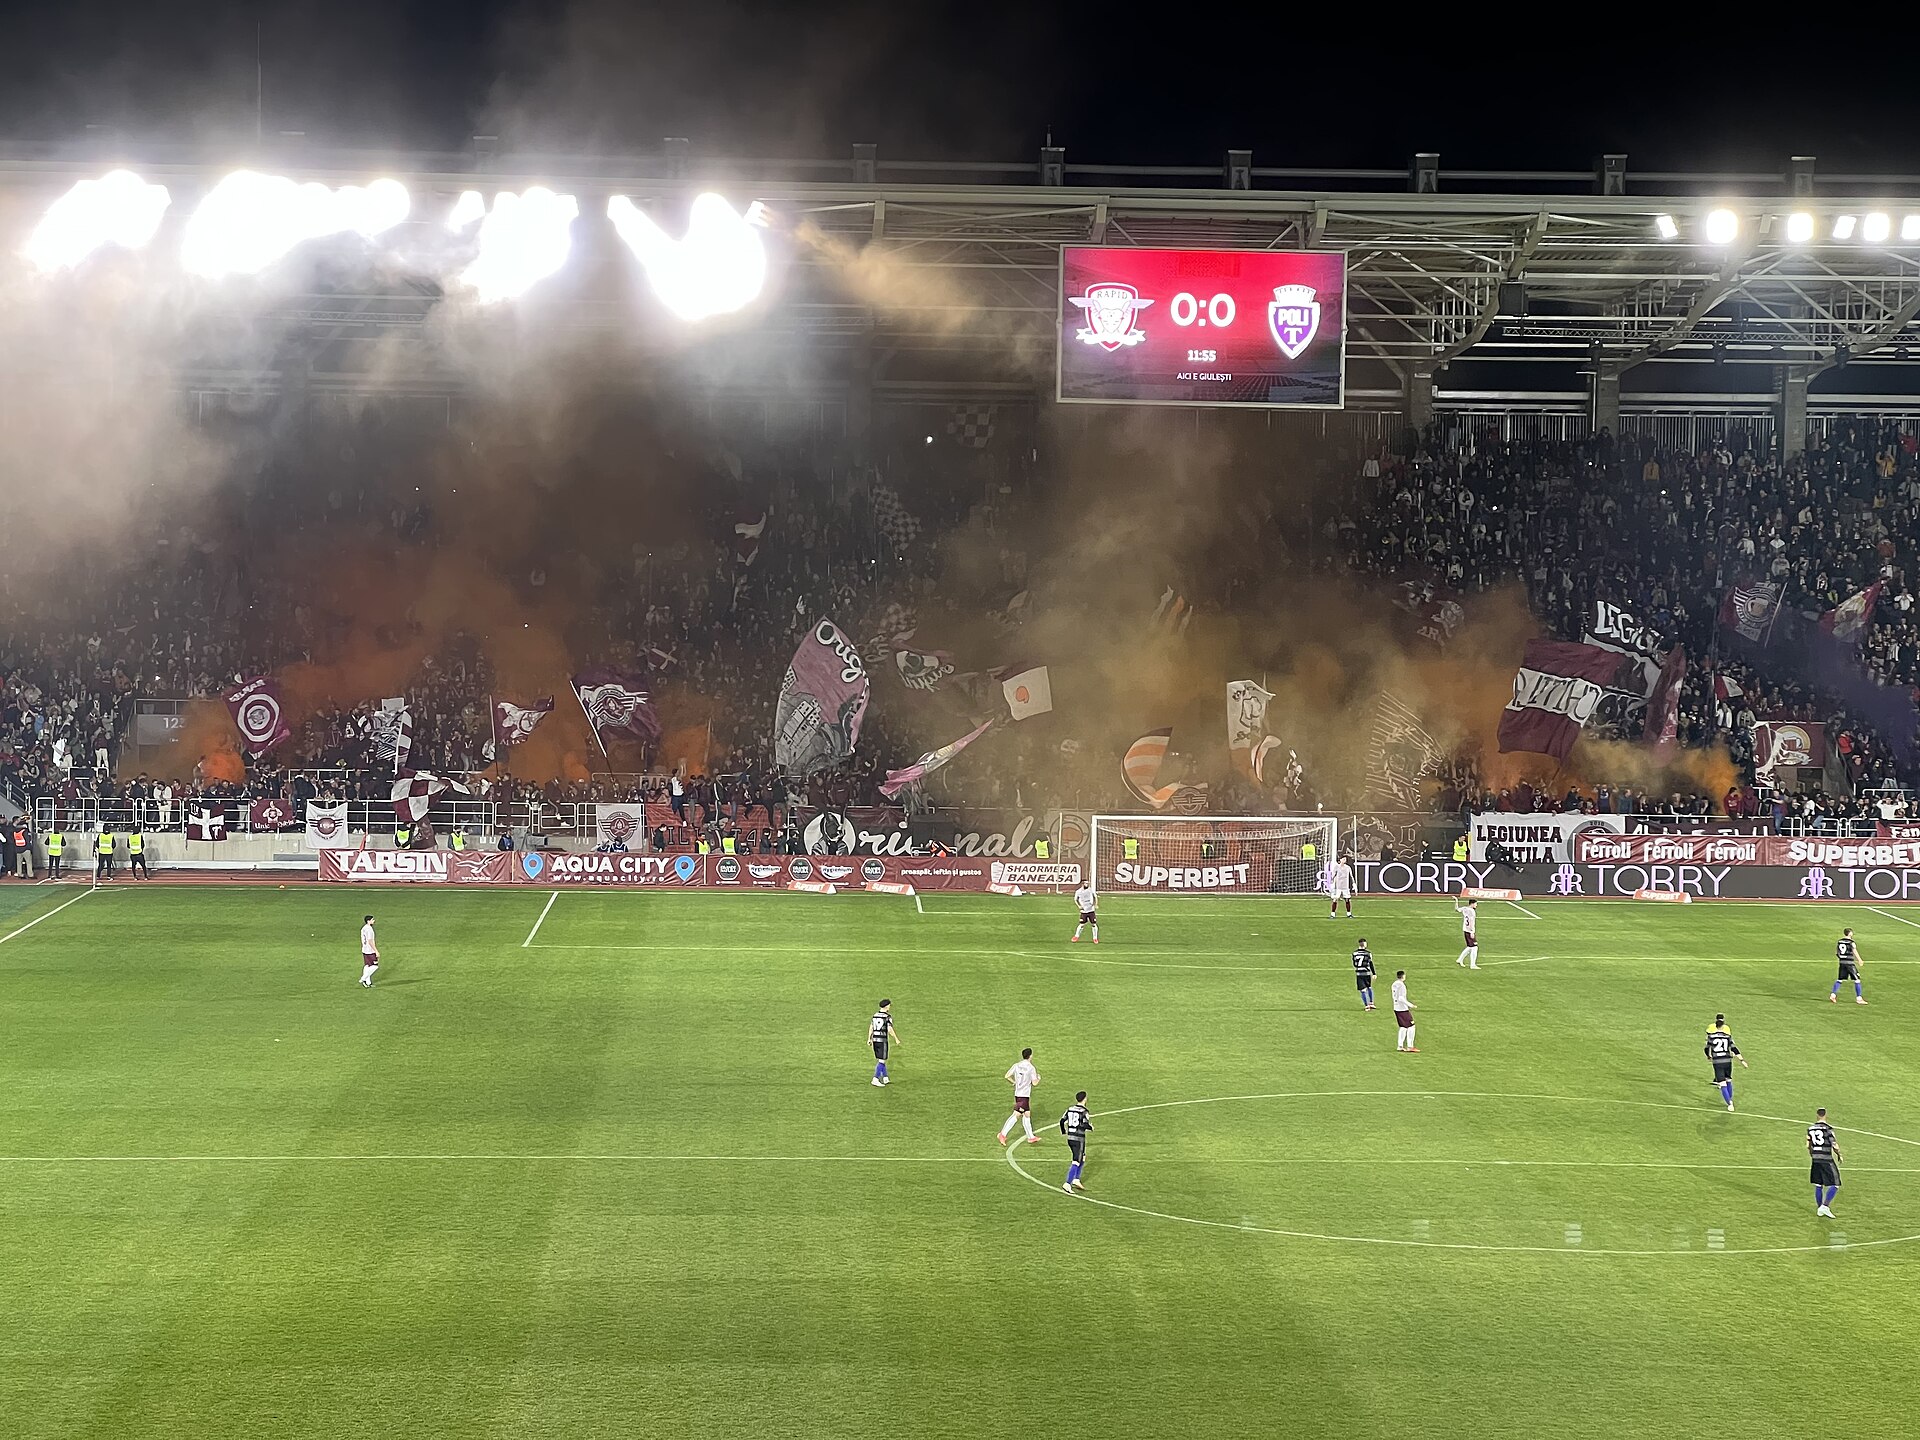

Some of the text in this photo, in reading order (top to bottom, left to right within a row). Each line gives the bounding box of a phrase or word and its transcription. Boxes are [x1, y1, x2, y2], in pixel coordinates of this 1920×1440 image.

[1097, 290, 1128, 300] RAPID
[1170, 292, 1236, 327] 0:0
[1278, 308, 1310, 326] POLI
[1283, 327, 1303, 345] T
[1187, 350, 1217, 362] 11:55
[1176, 372, 1192, 381] AICI
[1477, 825, 1562, 843] LEGIUNEA
[1789, 841, 1920, 865] SUPERBET
[335, 851, 447, 873] TARSIN
[551, 856, 669, 874] AQUA CITY
[1007, 865, 1078, 874] SHAORMERIA
[553, 874, 665, 883] www.aquacity.ro
[1115, 862, 1250, 888] SUPERBET
[1354, 862, 1496, 892] TORRY
[1587, 865, 1731, 895] TORRY
[1838, 943, 1847, 954] 9
[1355, 956, 1364, 967] 7
[872, 1018, 884, 1031] 19
[1712, 1038, 1729, 1051] 21
[1068, 1112, 1080, 1127] 18
[1809, 1130, 1825, 1146] 13
